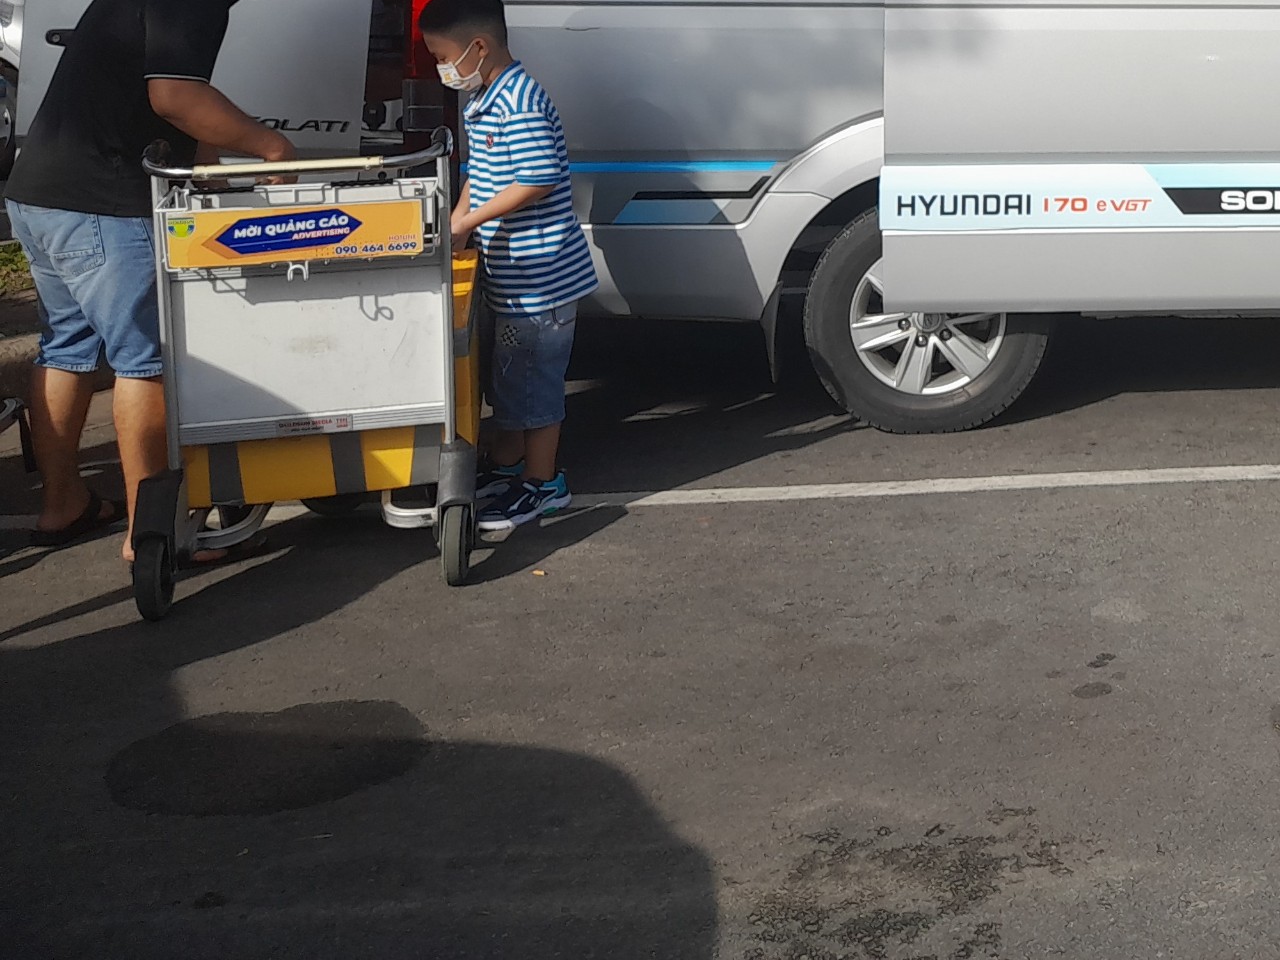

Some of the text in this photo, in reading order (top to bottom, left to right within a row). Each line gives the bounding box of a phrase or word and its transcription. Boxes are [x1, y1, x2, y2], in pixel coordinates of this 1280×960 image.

[255, 117, 350, 133] OLATI
[897, 194, 1031, 216] HYUNDAI
[1043, 197, 1088, 212] 170
[234, 214, 349, 239] MỜI QUẢNG CÁO
[291, 227, 350, 240] ADVERTISING
[335, 241, 417, 255] 090 464 6699
